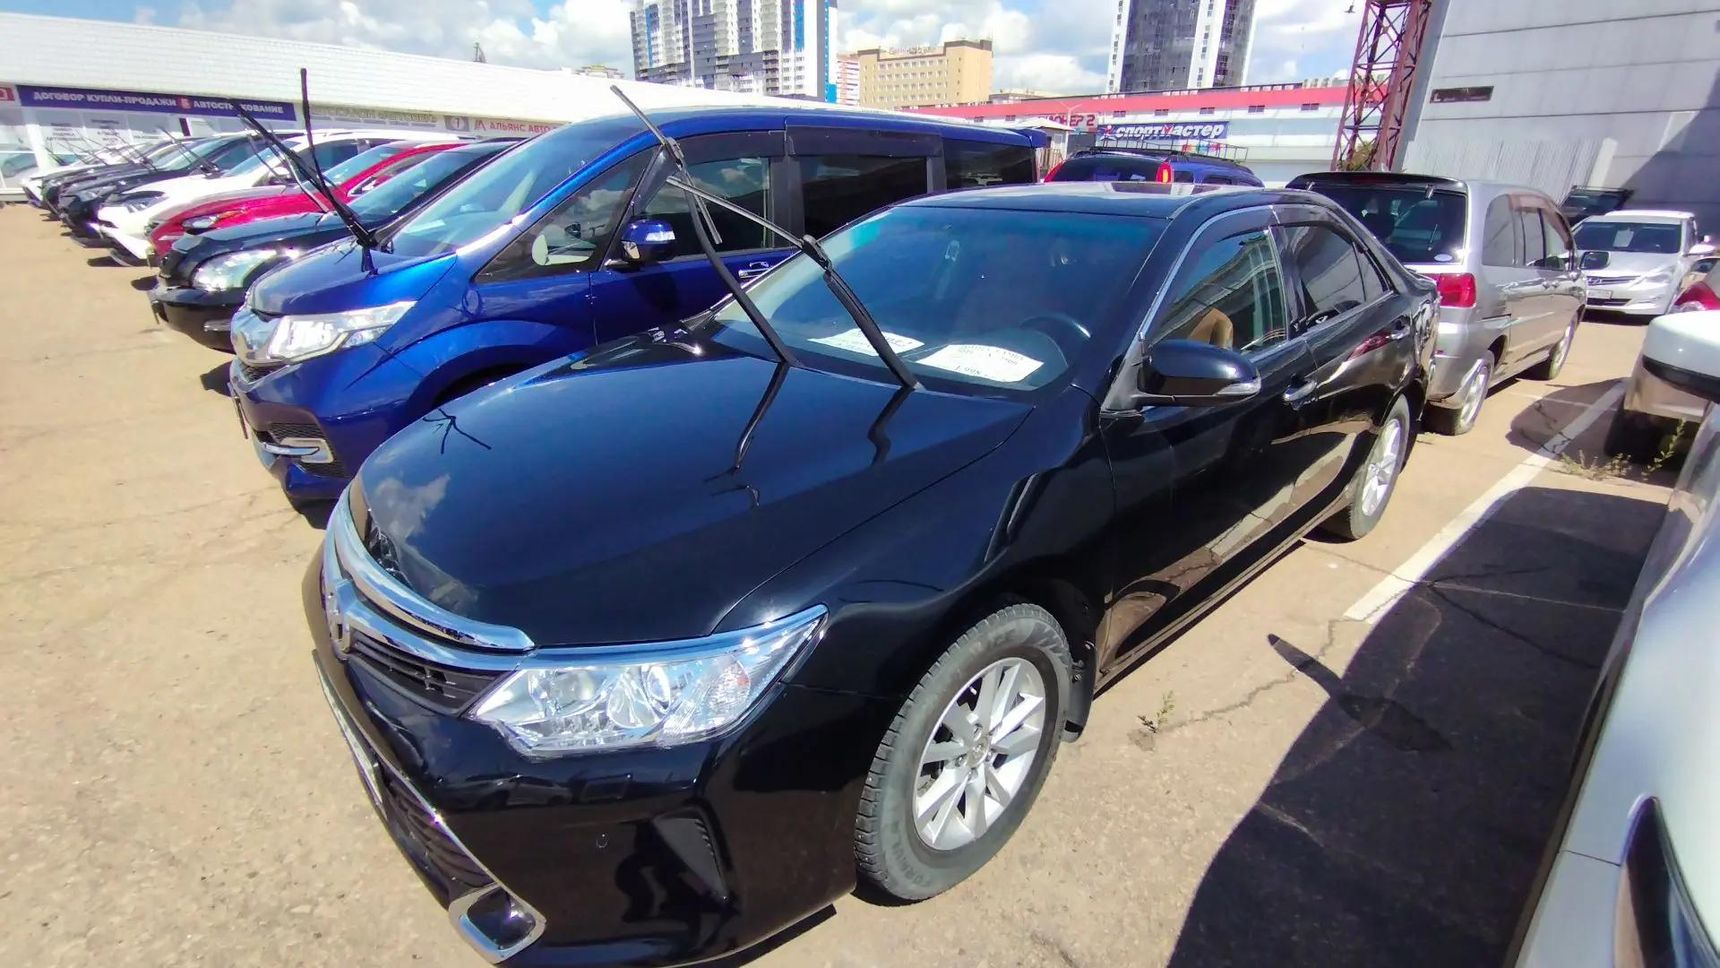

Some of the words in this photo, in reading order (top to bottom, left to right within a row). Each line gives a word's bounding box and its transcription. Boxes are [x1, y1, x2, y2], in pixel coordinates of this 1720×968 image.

[33, 91, 86, 101] ДОГОВОР
[193, 100, 284, 113] АВТОСТРХОВАНИЕ
[1086, 114, 1096, 126] 2
